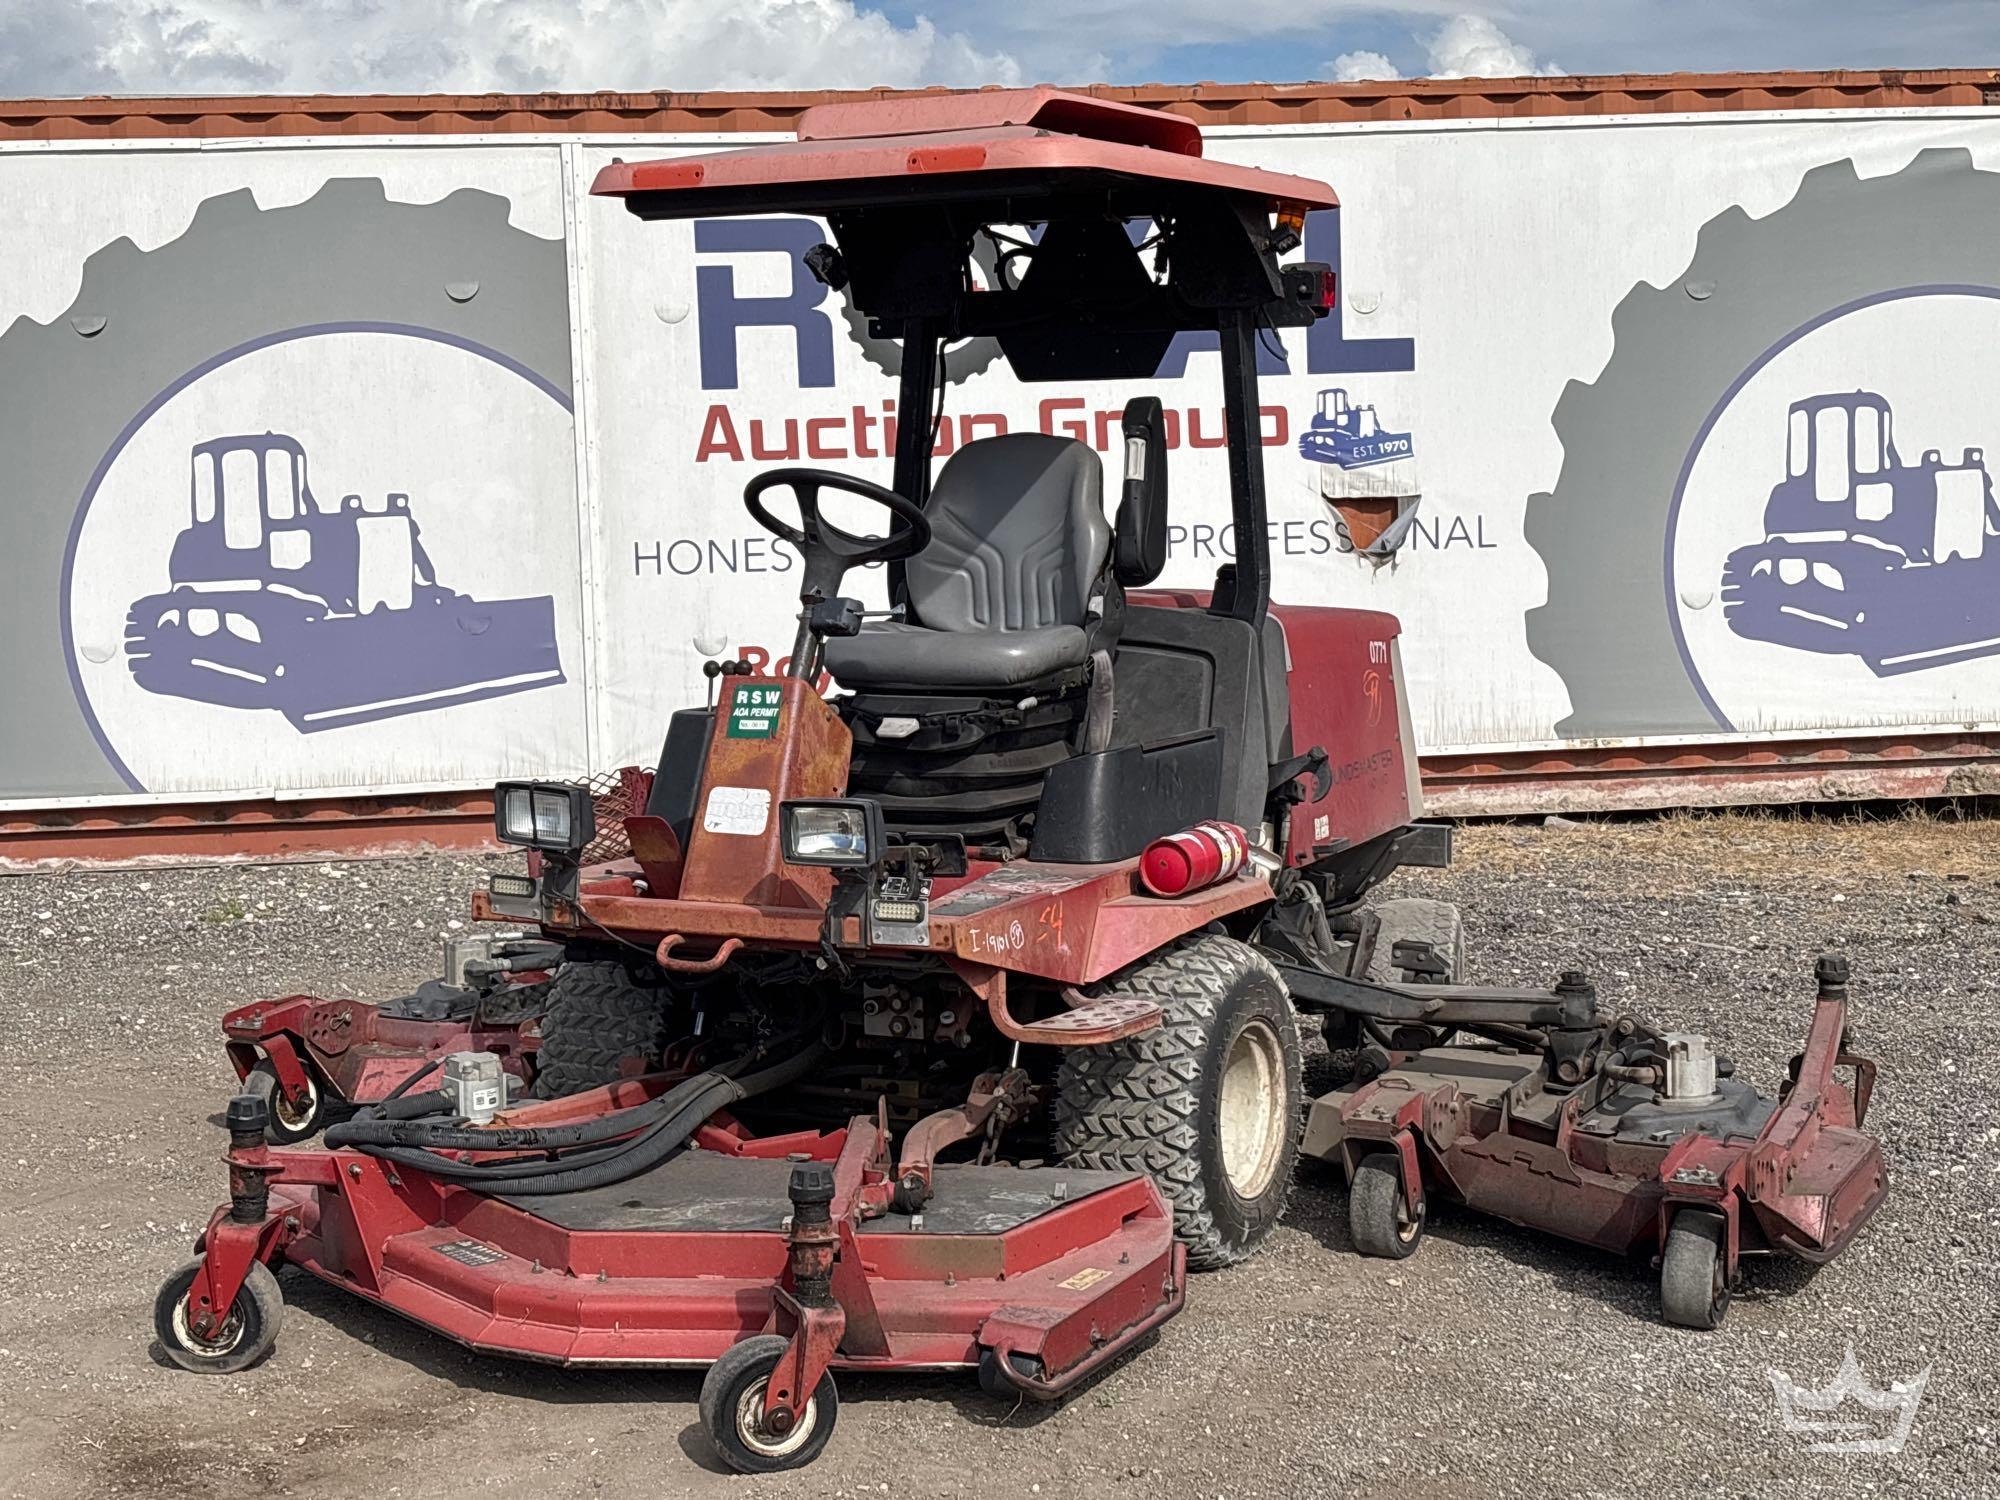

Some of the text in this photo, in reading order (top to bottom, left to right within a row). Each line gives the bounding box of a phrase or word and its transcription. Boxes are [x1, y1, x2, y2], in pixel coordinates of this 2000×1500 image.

[1353, 440, 1408, 458] EST. 1970
[1166, 515, 1498, 559] PRFESSNAL
[1369, 640, 1387, 664] 0771
[750, 708, 780, 718] PERMIT
